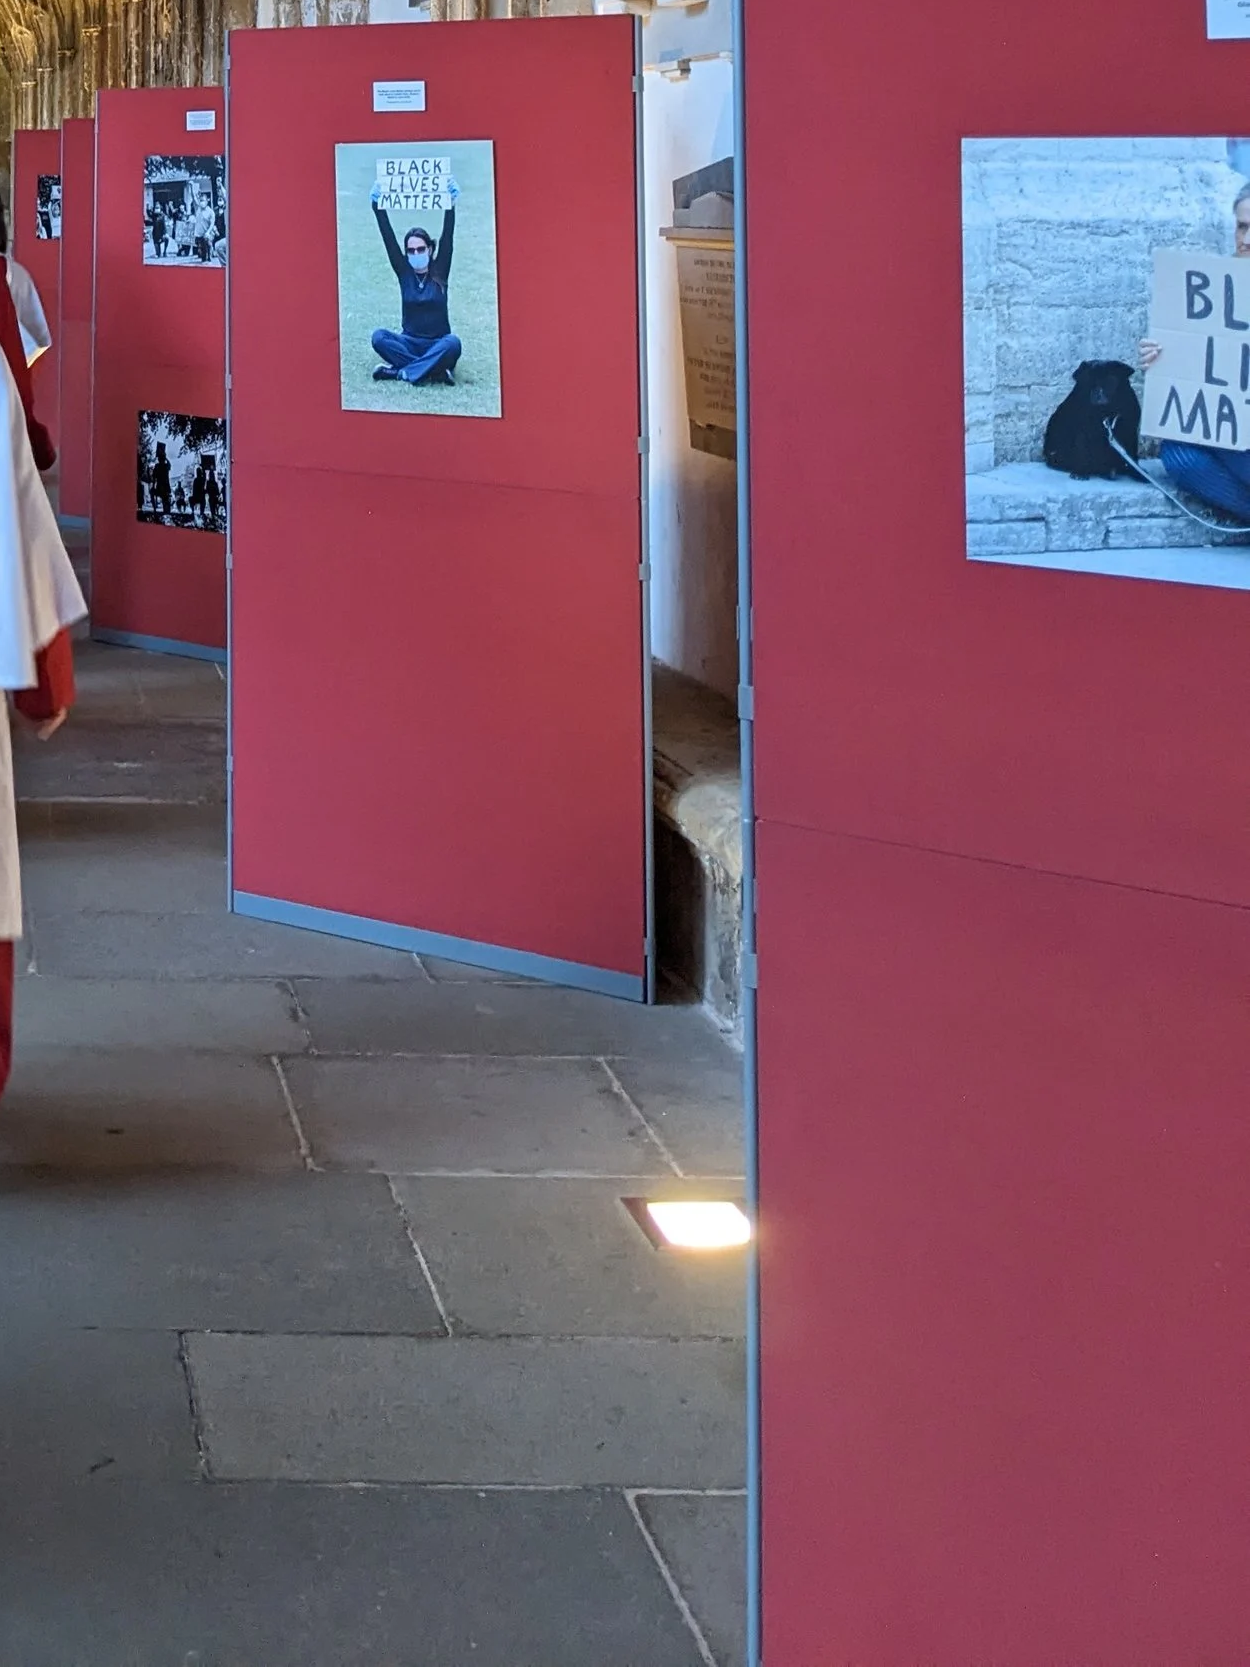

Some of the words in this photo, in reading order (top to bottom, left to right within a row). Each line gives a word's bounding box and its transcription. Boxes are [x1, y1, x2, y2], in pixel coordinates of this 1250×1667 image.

[386, 159, 442, 175] BLACK
[389, 176, 440, 193] LIVES
[381, 194, 443, 209] MATTER
[1186, 270, 1250, 331] BL
[1205, 336, 1250, 392] LI
[1159, 385, 1250, 446] MA
